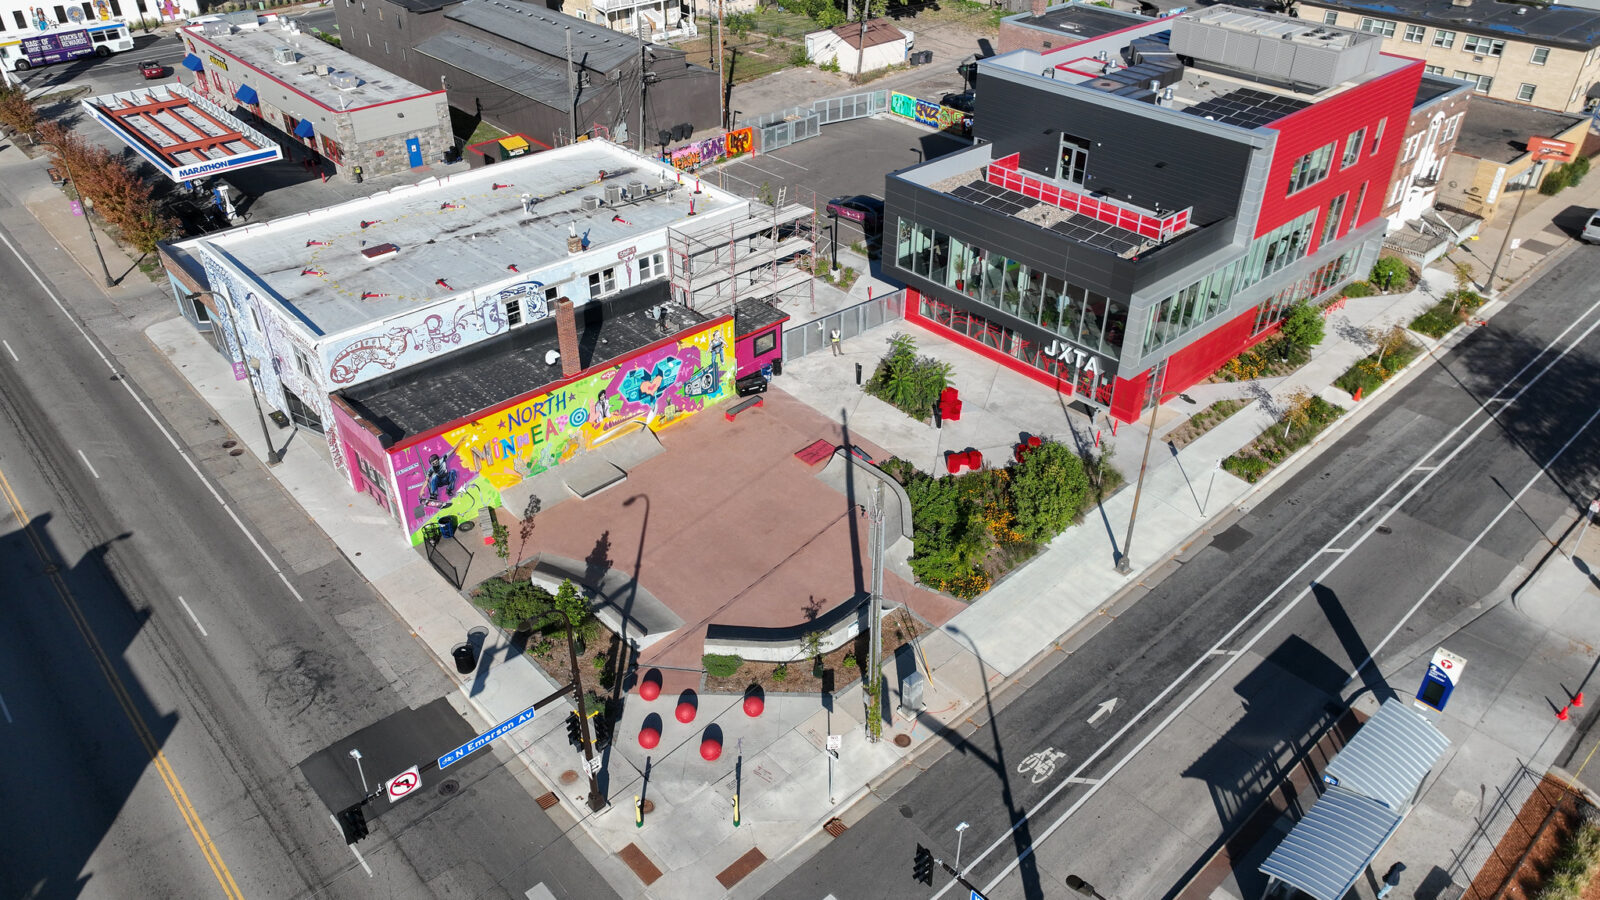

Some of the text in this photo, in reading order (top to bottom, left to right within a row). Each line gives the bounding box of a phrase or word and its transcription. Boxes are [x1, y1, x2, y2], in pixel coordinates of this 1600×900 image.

[61, 39, 87, 47] REWARDS
[179, 161, 228, 177] MARATHON
[1044, 339, 1101, 376] JXTA
[507, 391, 567, 432] NORTH
[455, 711, 532, 758] N Emerson Av
